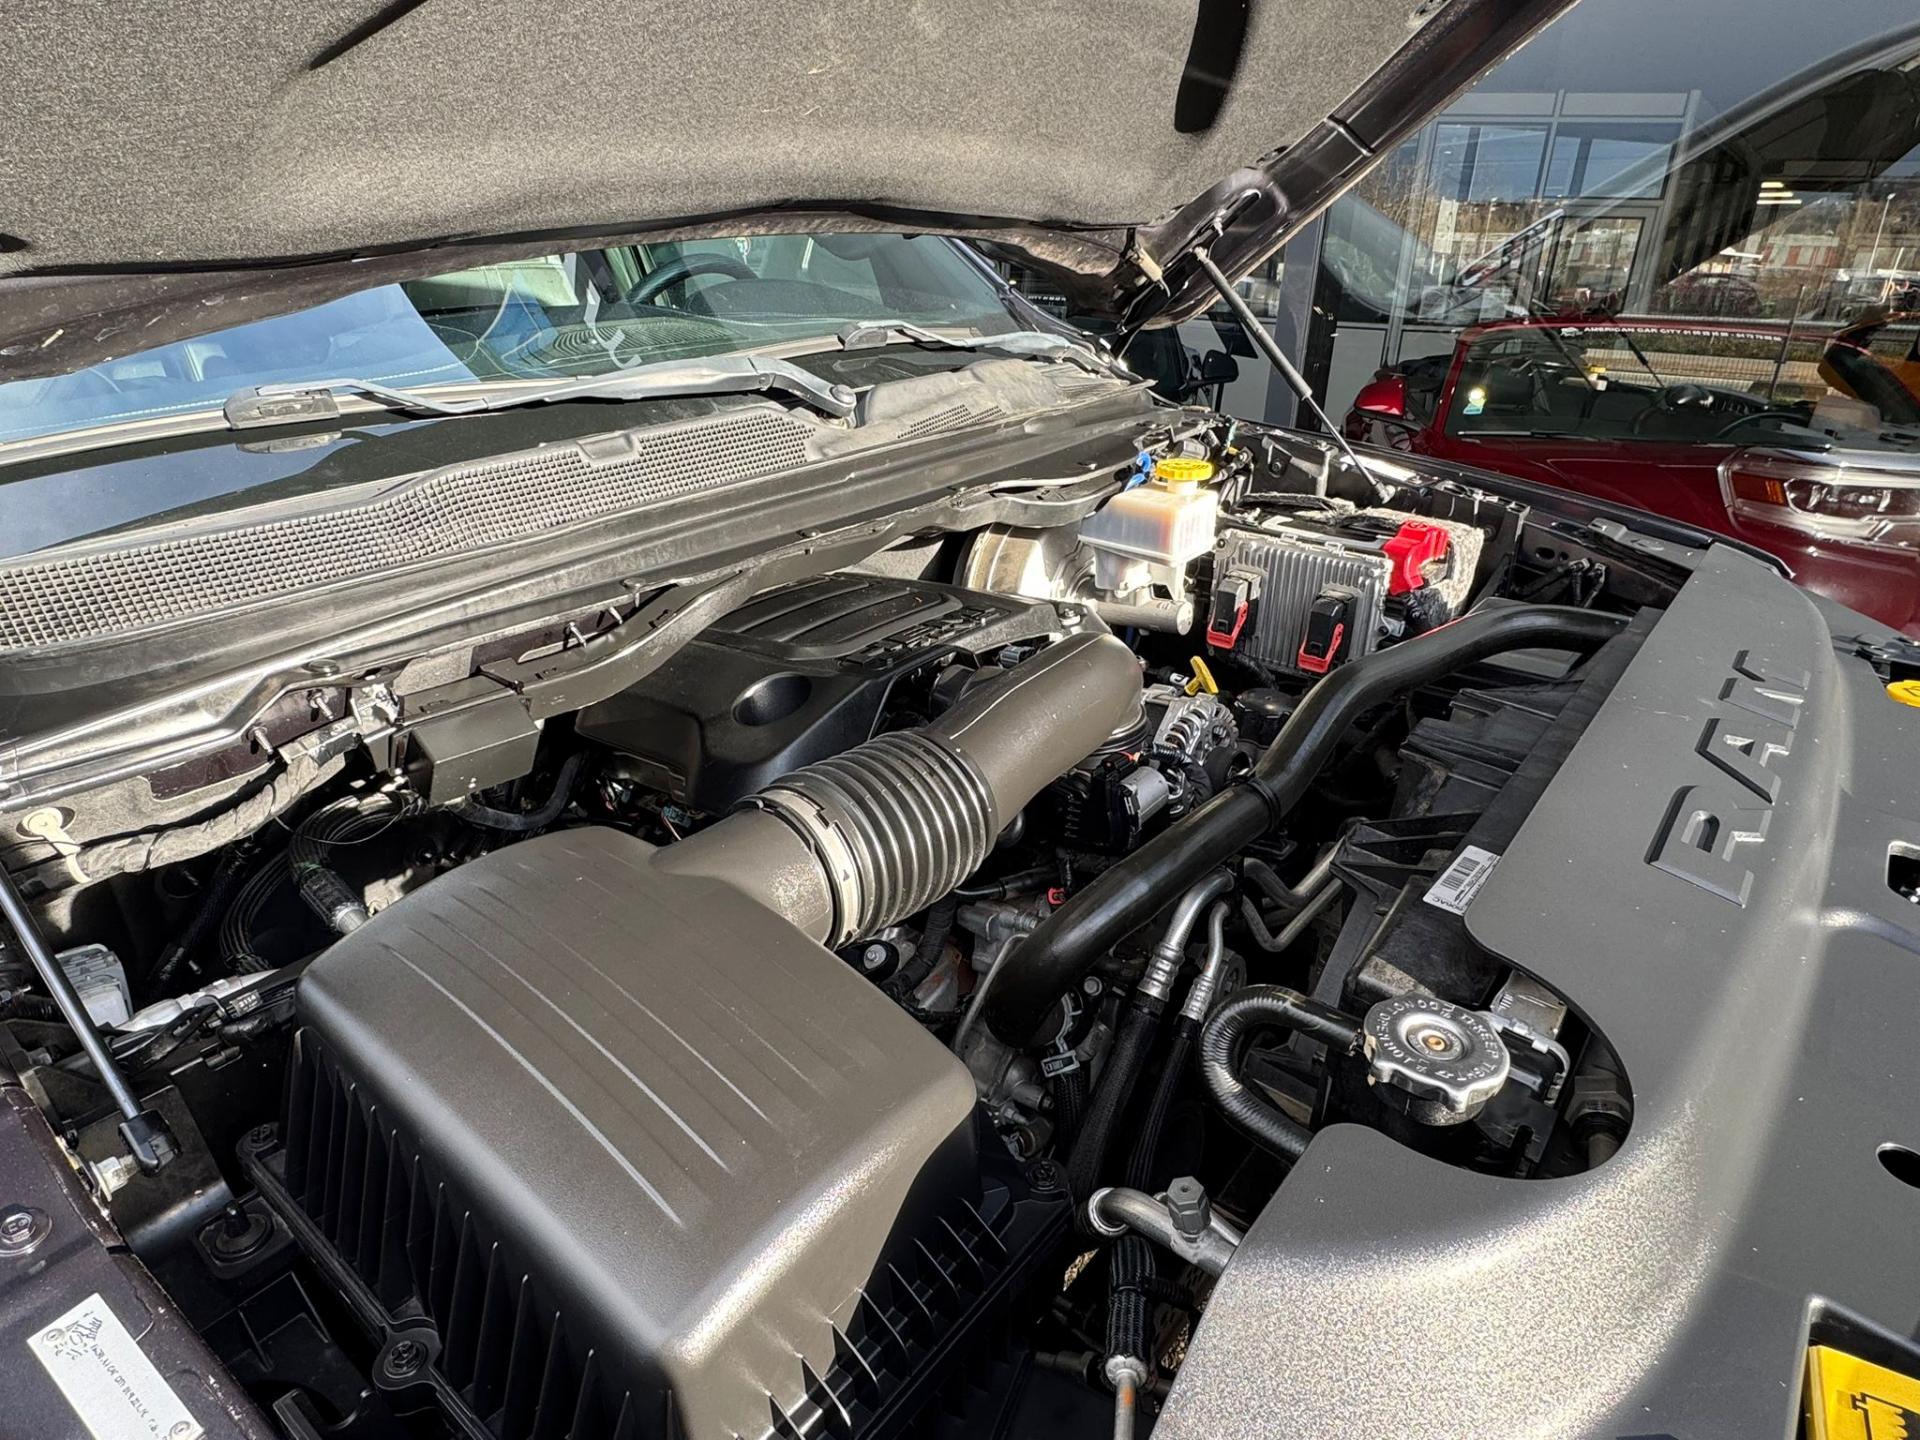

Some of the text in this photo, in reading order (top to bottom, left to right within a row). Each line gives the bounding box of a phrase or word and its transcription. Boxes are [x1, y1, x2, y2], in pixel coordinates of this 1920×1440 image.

[1643, 649, 1812, 908] RAM
[1389, 1000, 1415, 1016] NOT
[1456, 1023, 1500, 1082] KEEP TIGHT
